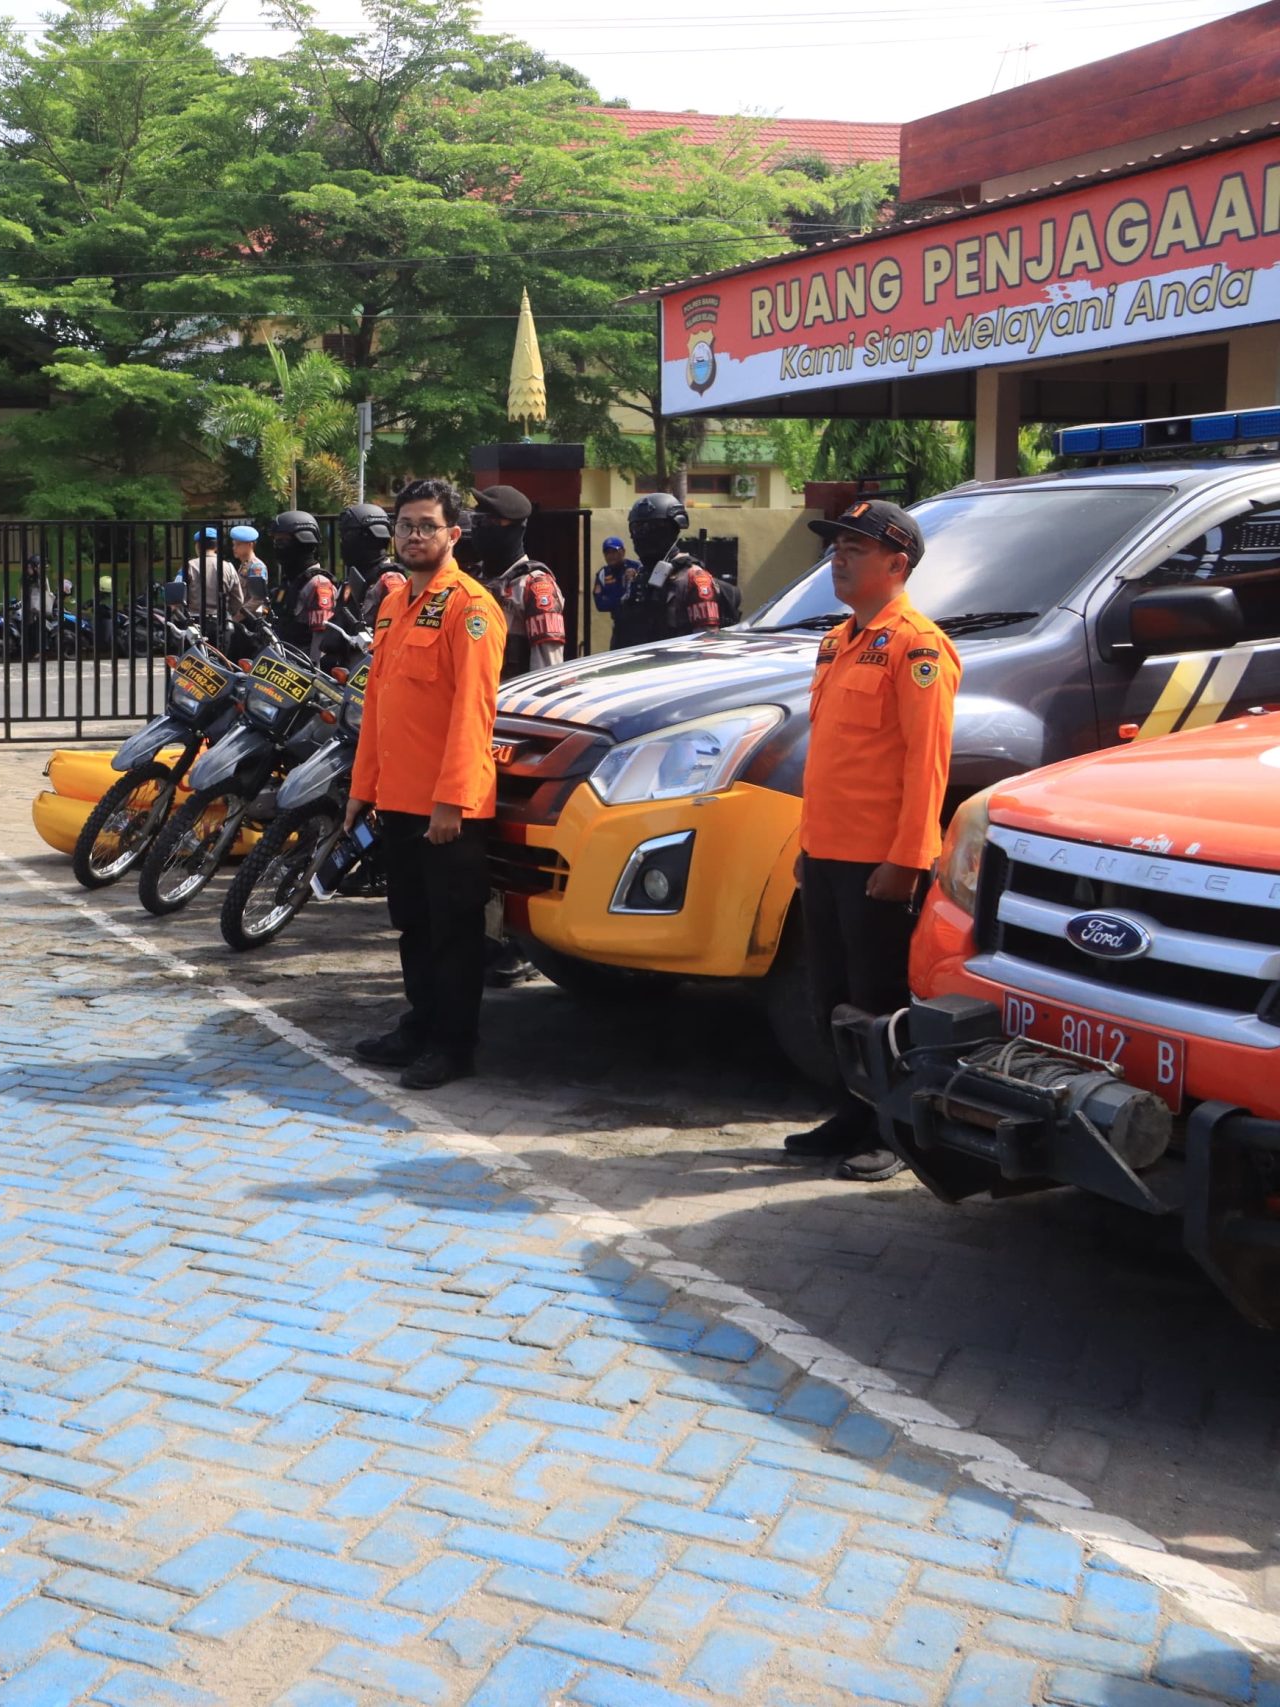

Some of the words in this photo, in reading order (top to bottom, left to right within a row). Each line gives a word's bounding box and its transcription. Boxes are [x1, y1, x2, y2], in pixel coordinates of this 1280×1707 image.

[751, 256, 902, 338] RUANG
[780, 332, 856, 380] Kami
[863, 324, 933, 372] Siap
[941, 283, 1118, 355] Melayani
[1125, 262, 1255, 326] Anda
[201, 665, 216, 677] XIV
[284, 669, 300, 680] XIV
[1081, 919, 1126, 949] Ford
[1006, 996, 1035, 1038] DP
[1061, 1015, 1126, 1066] 8012
[1157, 1039, 1176, 1085] B
